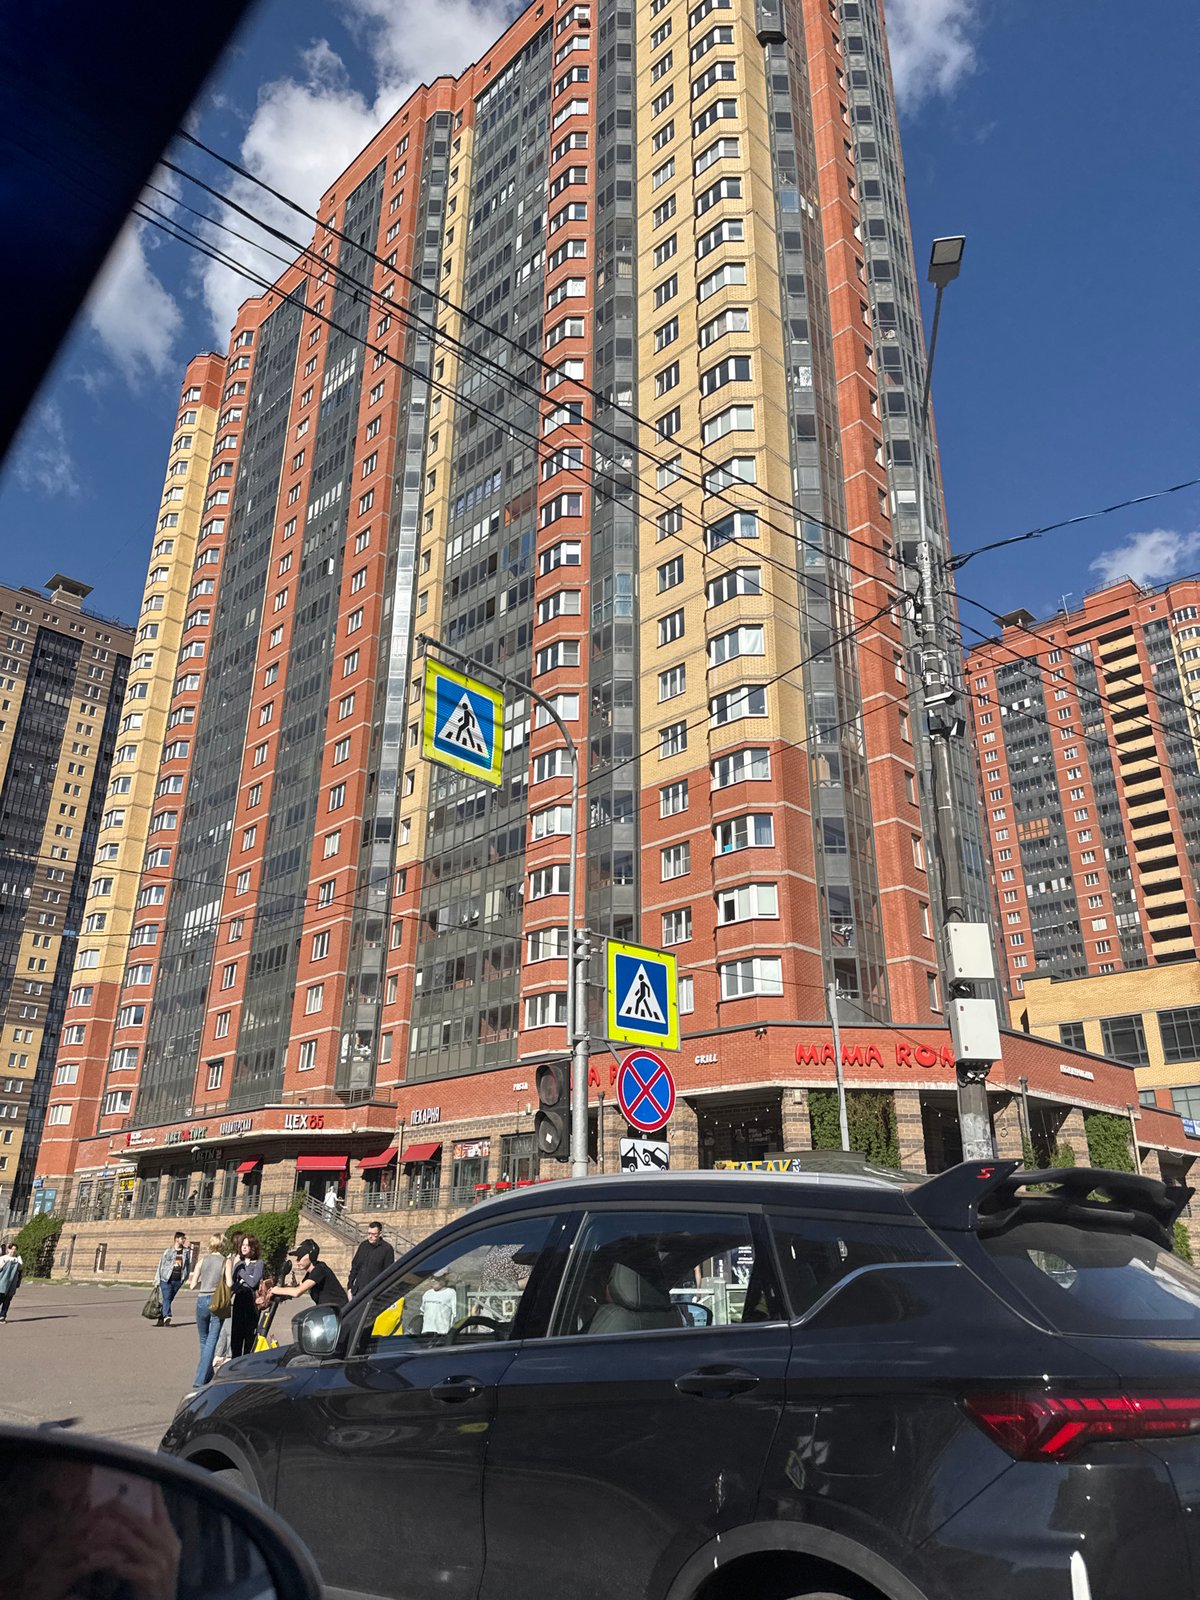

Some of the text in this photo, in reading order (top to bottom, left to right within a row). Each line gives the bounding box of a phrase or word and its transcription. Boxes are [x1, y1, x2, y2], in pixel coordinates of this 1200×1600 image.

[694, 1054, 719, 1065] GRILL
[795, 1042, 956, 1068] MAMA ROM
[284, 1114, 324, 1131] ЦЕХ 85
[410, 1107, 440, 1126] ПЕКАРНЯ
